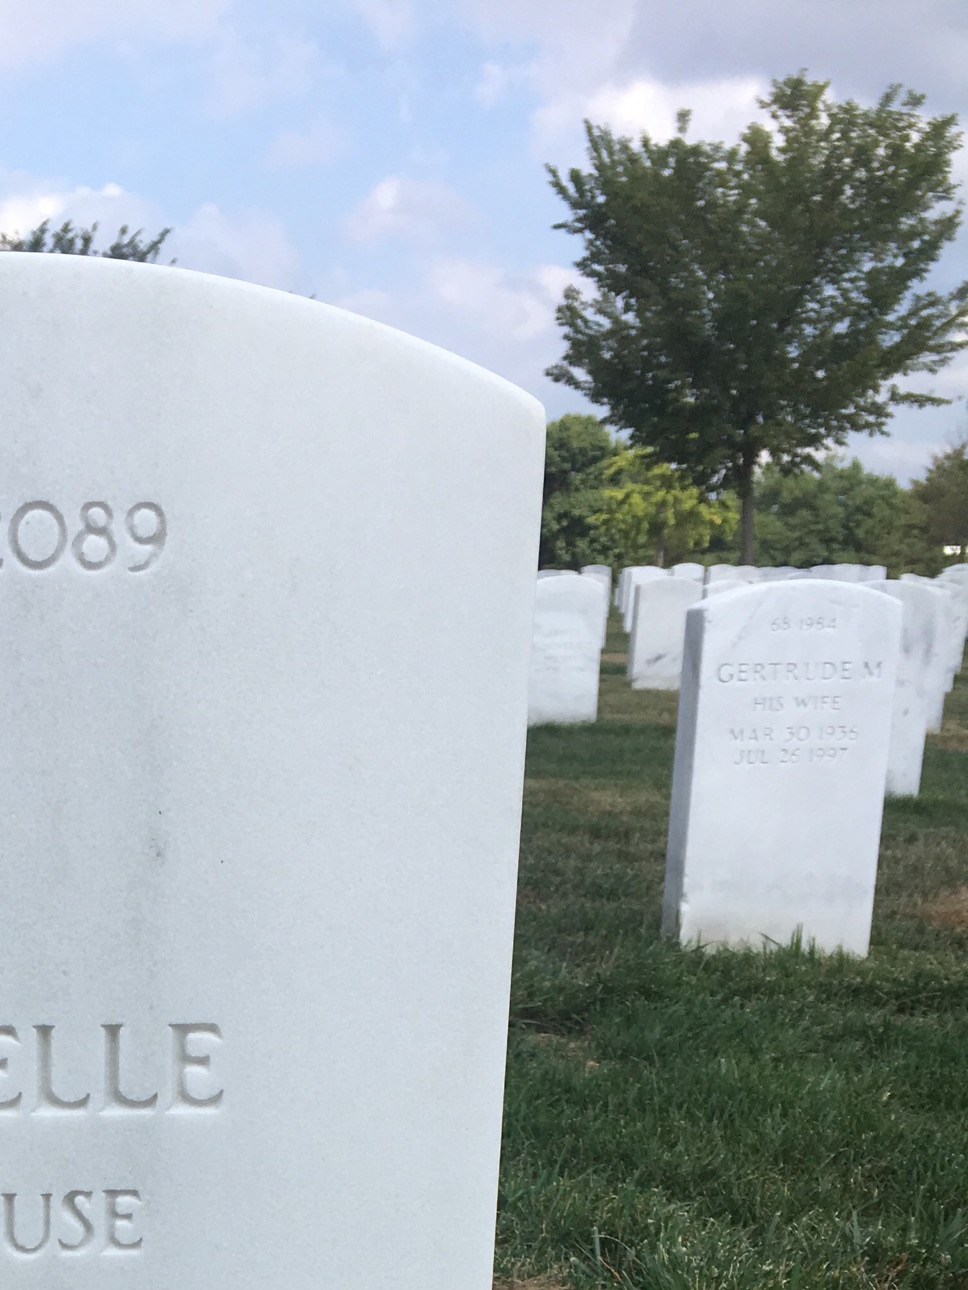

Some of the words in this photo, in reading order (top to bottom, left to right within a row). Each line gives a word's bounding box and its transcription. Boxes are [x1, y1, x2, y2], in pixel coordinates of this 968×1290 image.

[716, 661, 853, 683] GERTRUDE
[862, 660, 884, 680] M
[753, 696, 784, 712] HIS
[792, 695, 842, 711] WIFE
[728, 726, 774, 742] MAR
[785, 725, 810, 742] 30
[733, 748, 769, 765] JUL
[779, 747, 801, 764] 26
[808, 747, 849, 764] 1997
